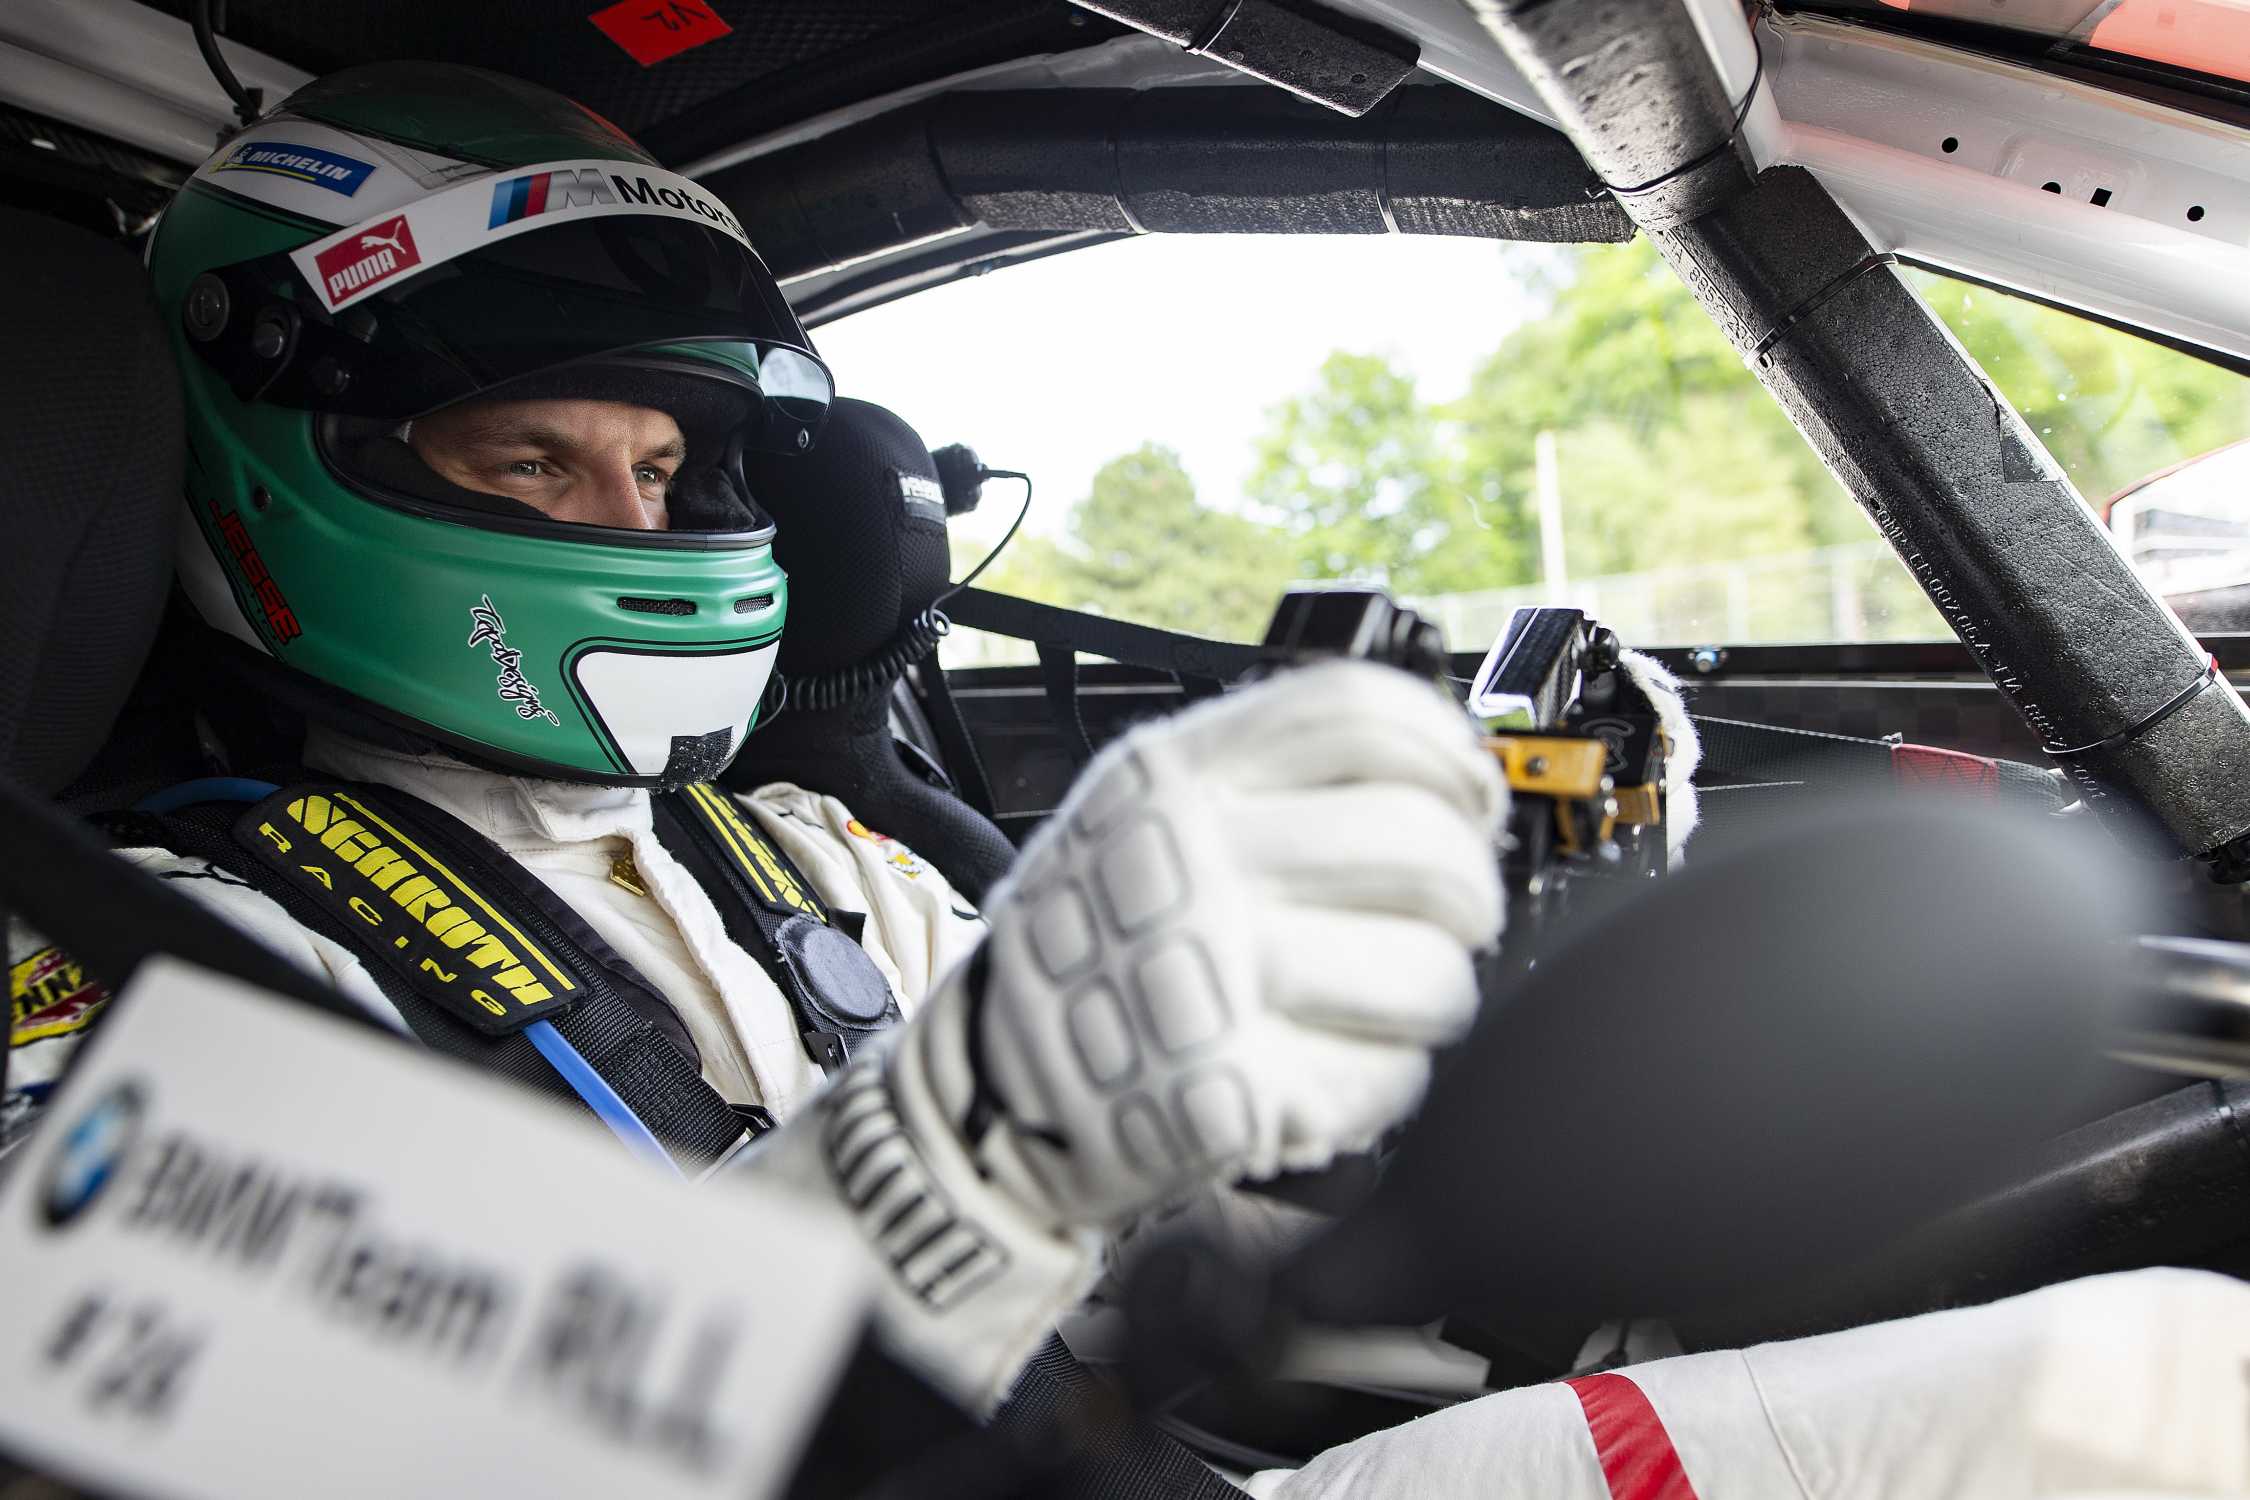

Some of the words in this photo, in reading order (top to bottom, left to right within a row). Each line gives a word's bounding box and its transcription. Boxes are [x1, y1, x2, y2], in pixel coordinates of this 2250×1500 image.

[249, 149, 353, 182] MICHELIN
[328, 248, 397, 298] PUMA
[1663, 231, 1684, 263] FIA
[1689, 266, 1758, 352] 8857-200
[207, 498, 303, 646] JESSE
[258, 822, 508, 1017] RACING
[286, 795, 554, 1006] SCHROTH
